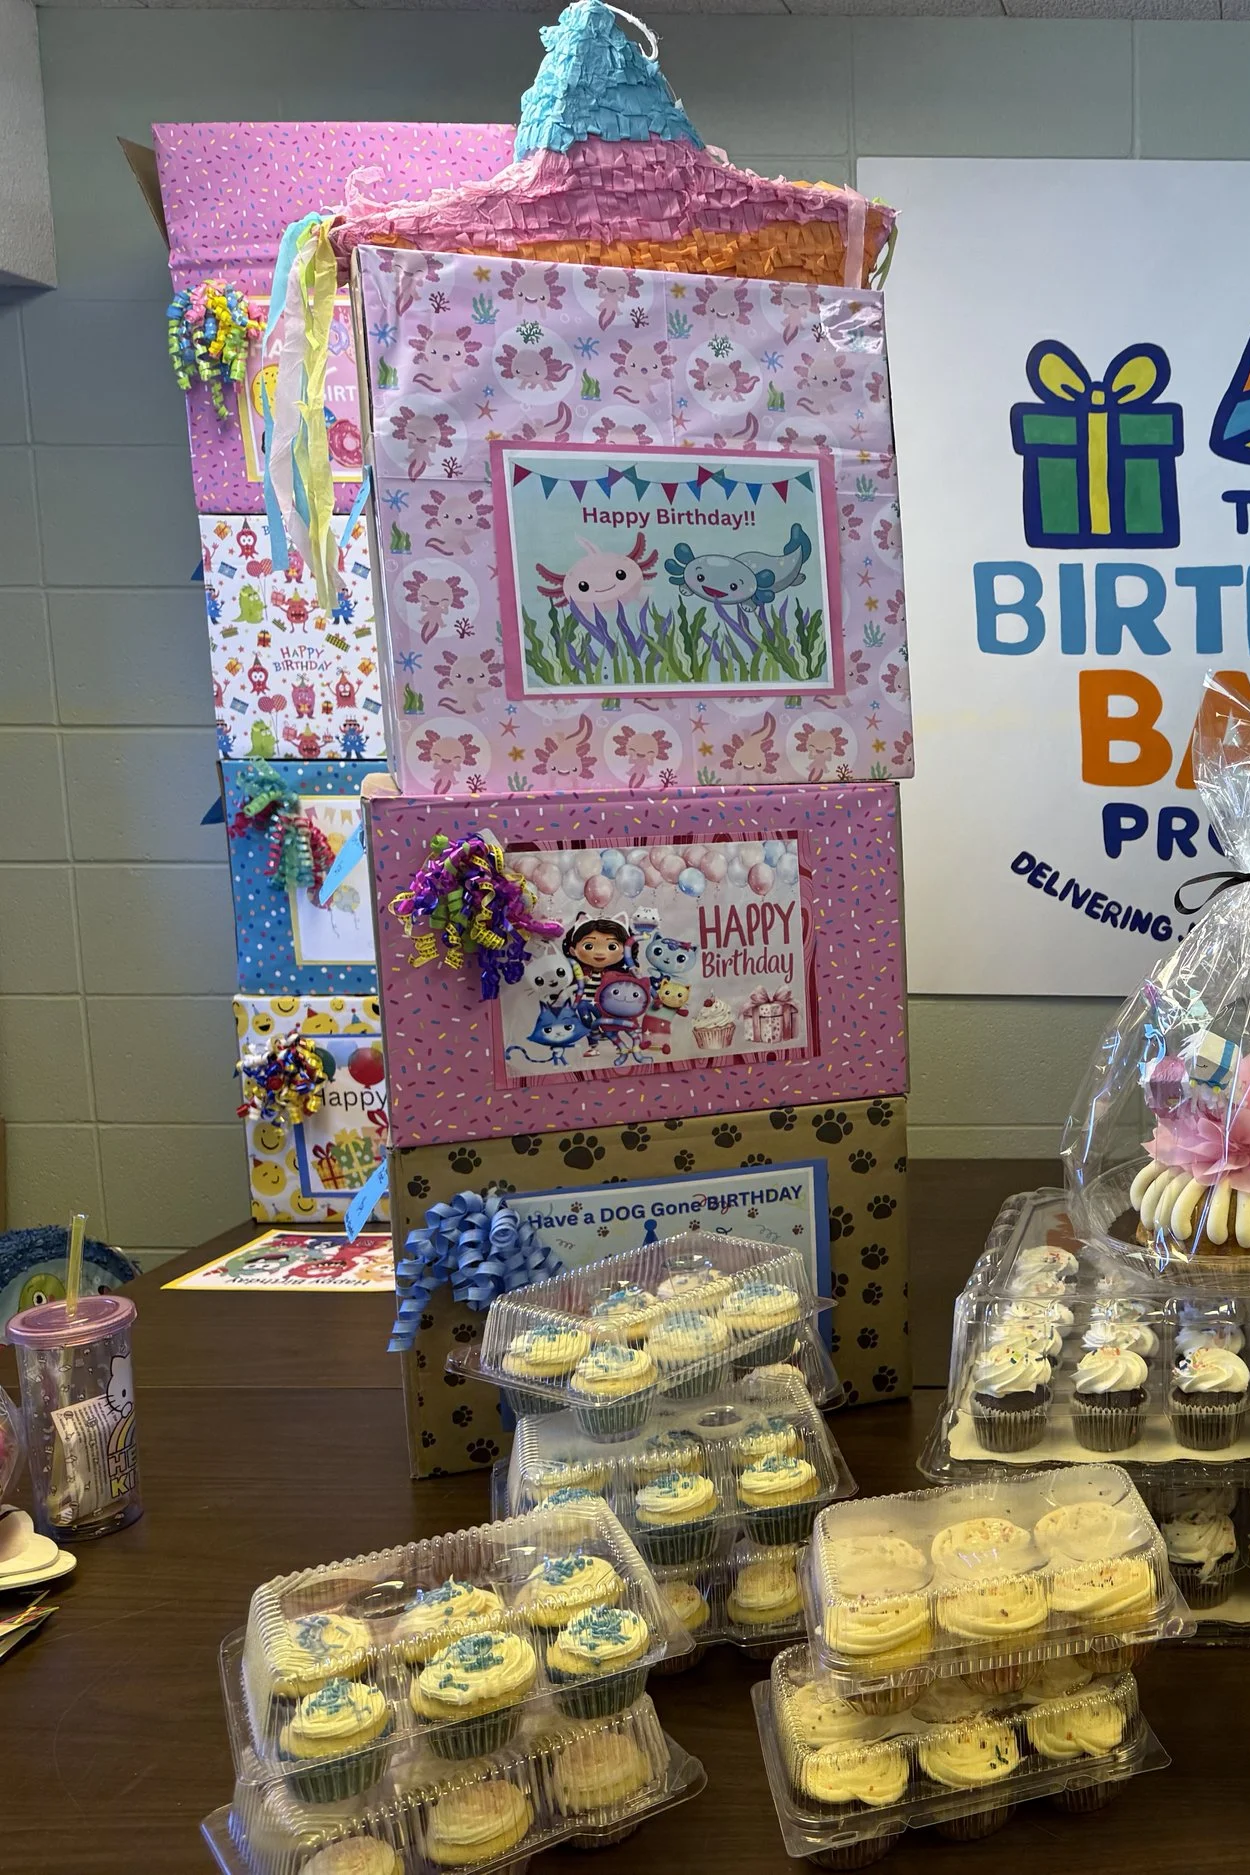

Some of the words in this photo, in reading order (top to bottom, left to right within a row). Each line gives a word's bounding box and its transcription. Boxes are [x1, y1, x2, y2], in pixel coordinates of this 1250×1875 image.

[582, 507, 650, 528] Happy
[656, 508, 756, 530] Birthday!!
[272, 659, 332, 672] BIRTHDAY
[280, 645, 325, 659] HAPPY
[1010, 850, 1173, 941] DELIVERING
[698, 900, 796, 950] HAPPY
[701, 946, 794, 984] Birthday
[527, 1212, 578, 1230] Have
[583, 1212, 596, 1225] a
[600, 1204, 646, 1223] DOG
[651, 1200, 702, 1218] Gone
[706, 1184, 803, 1211] BIRTHDAY
